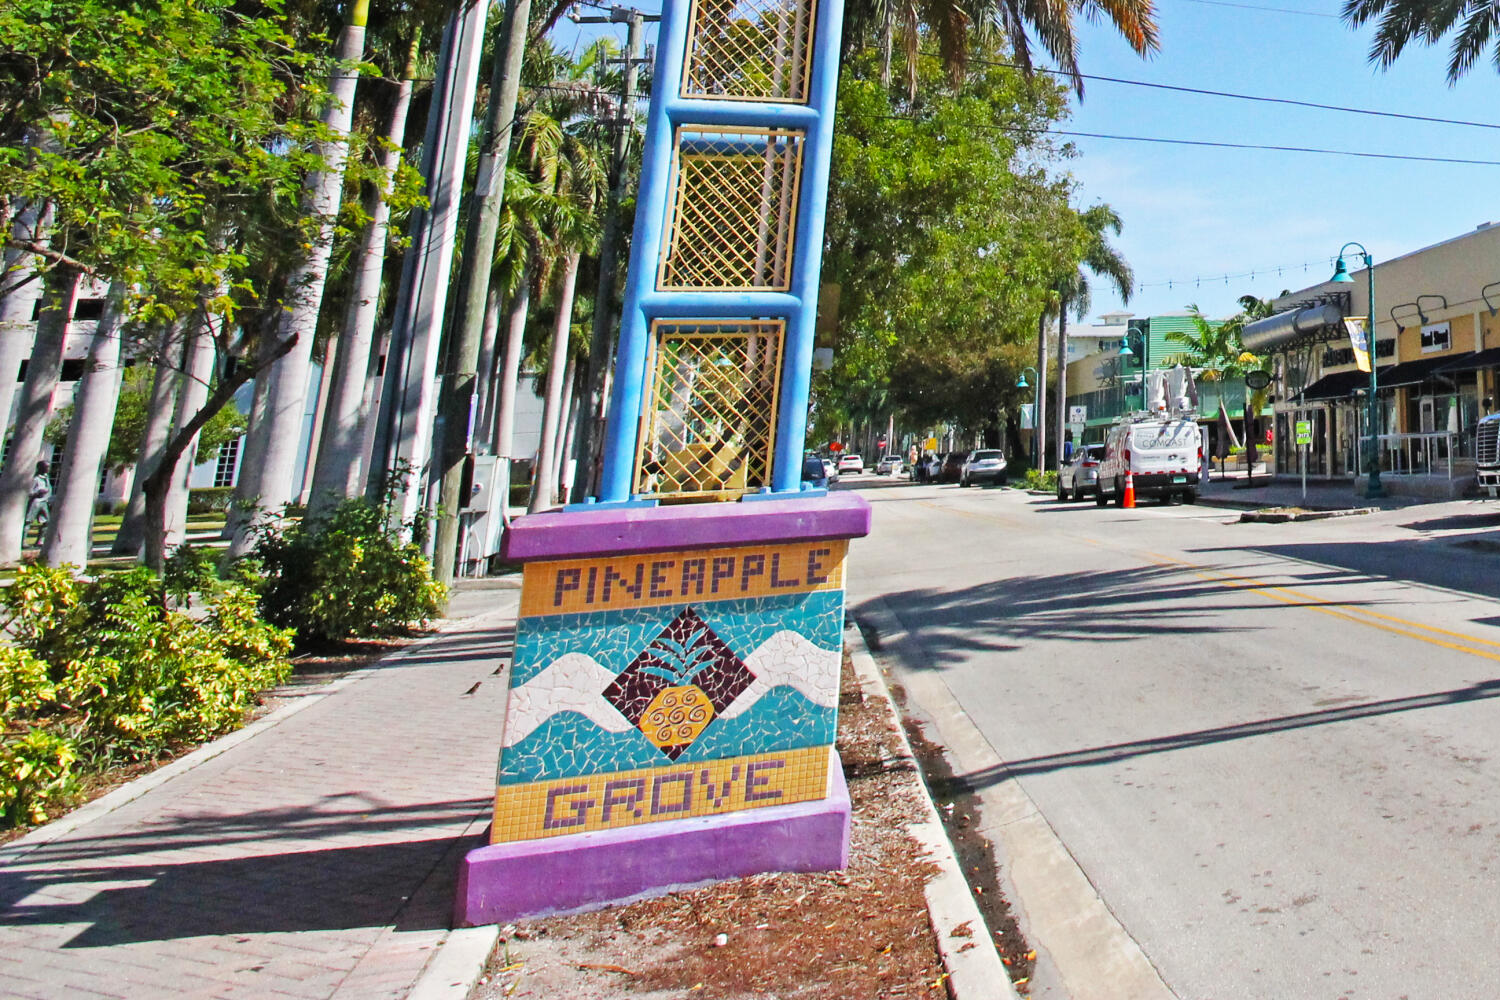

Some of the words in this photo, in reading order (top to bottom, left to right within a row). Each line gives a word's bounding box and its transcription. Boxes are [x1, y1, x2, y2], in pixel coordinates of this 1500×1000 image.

[1142, 438, 1187, 448] COMCAST
[553, 549, 831, 606] PINEAPPLE
[543, 760, 785, 831] GROVE
